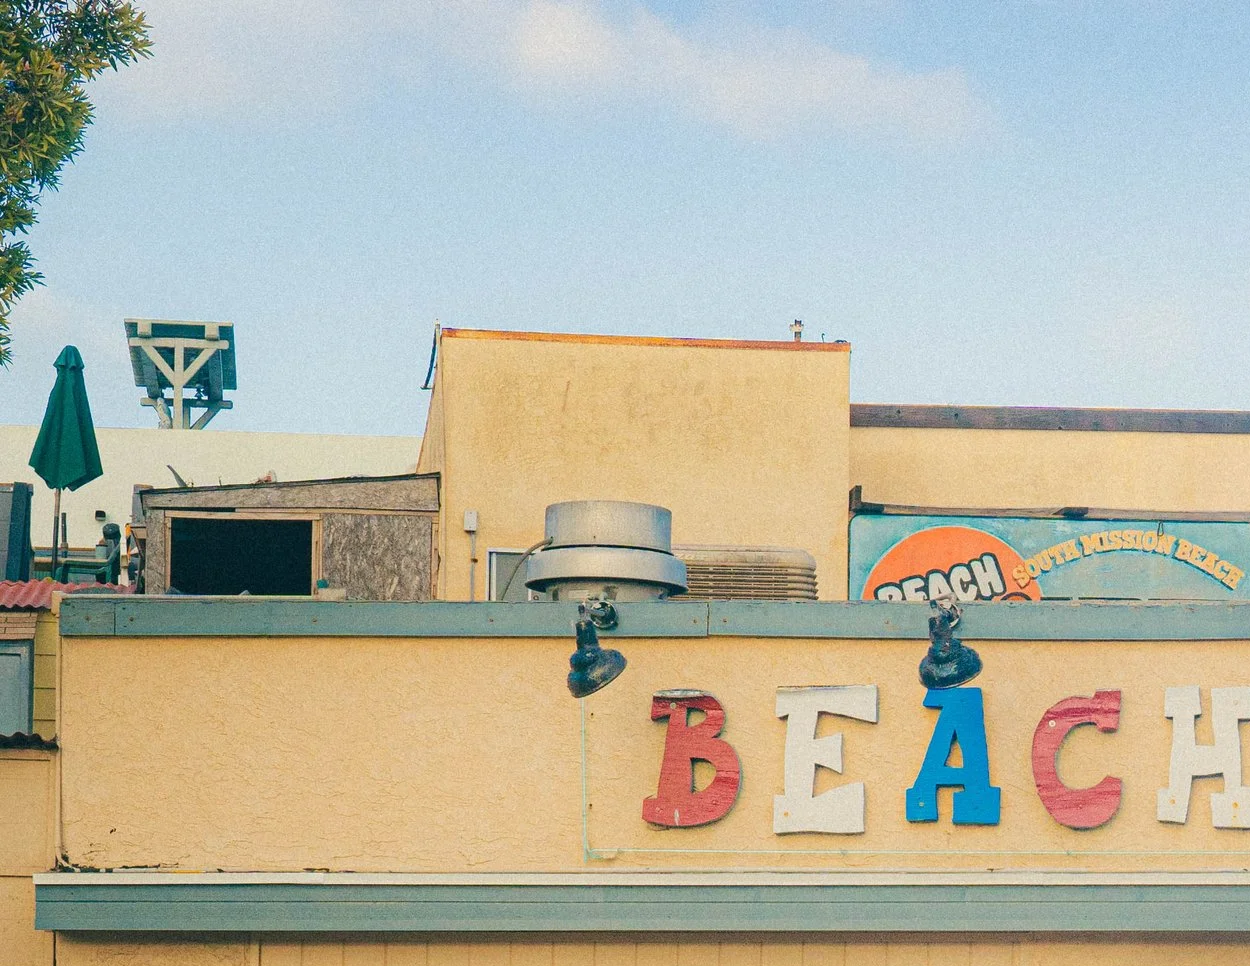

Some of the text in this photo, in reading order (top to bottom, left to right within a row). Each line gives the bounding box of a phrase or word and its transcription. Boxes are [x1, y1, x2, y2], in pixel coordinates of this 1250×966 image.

[1012, 529, 1245, 591] SOUTH MISSION BEACH
